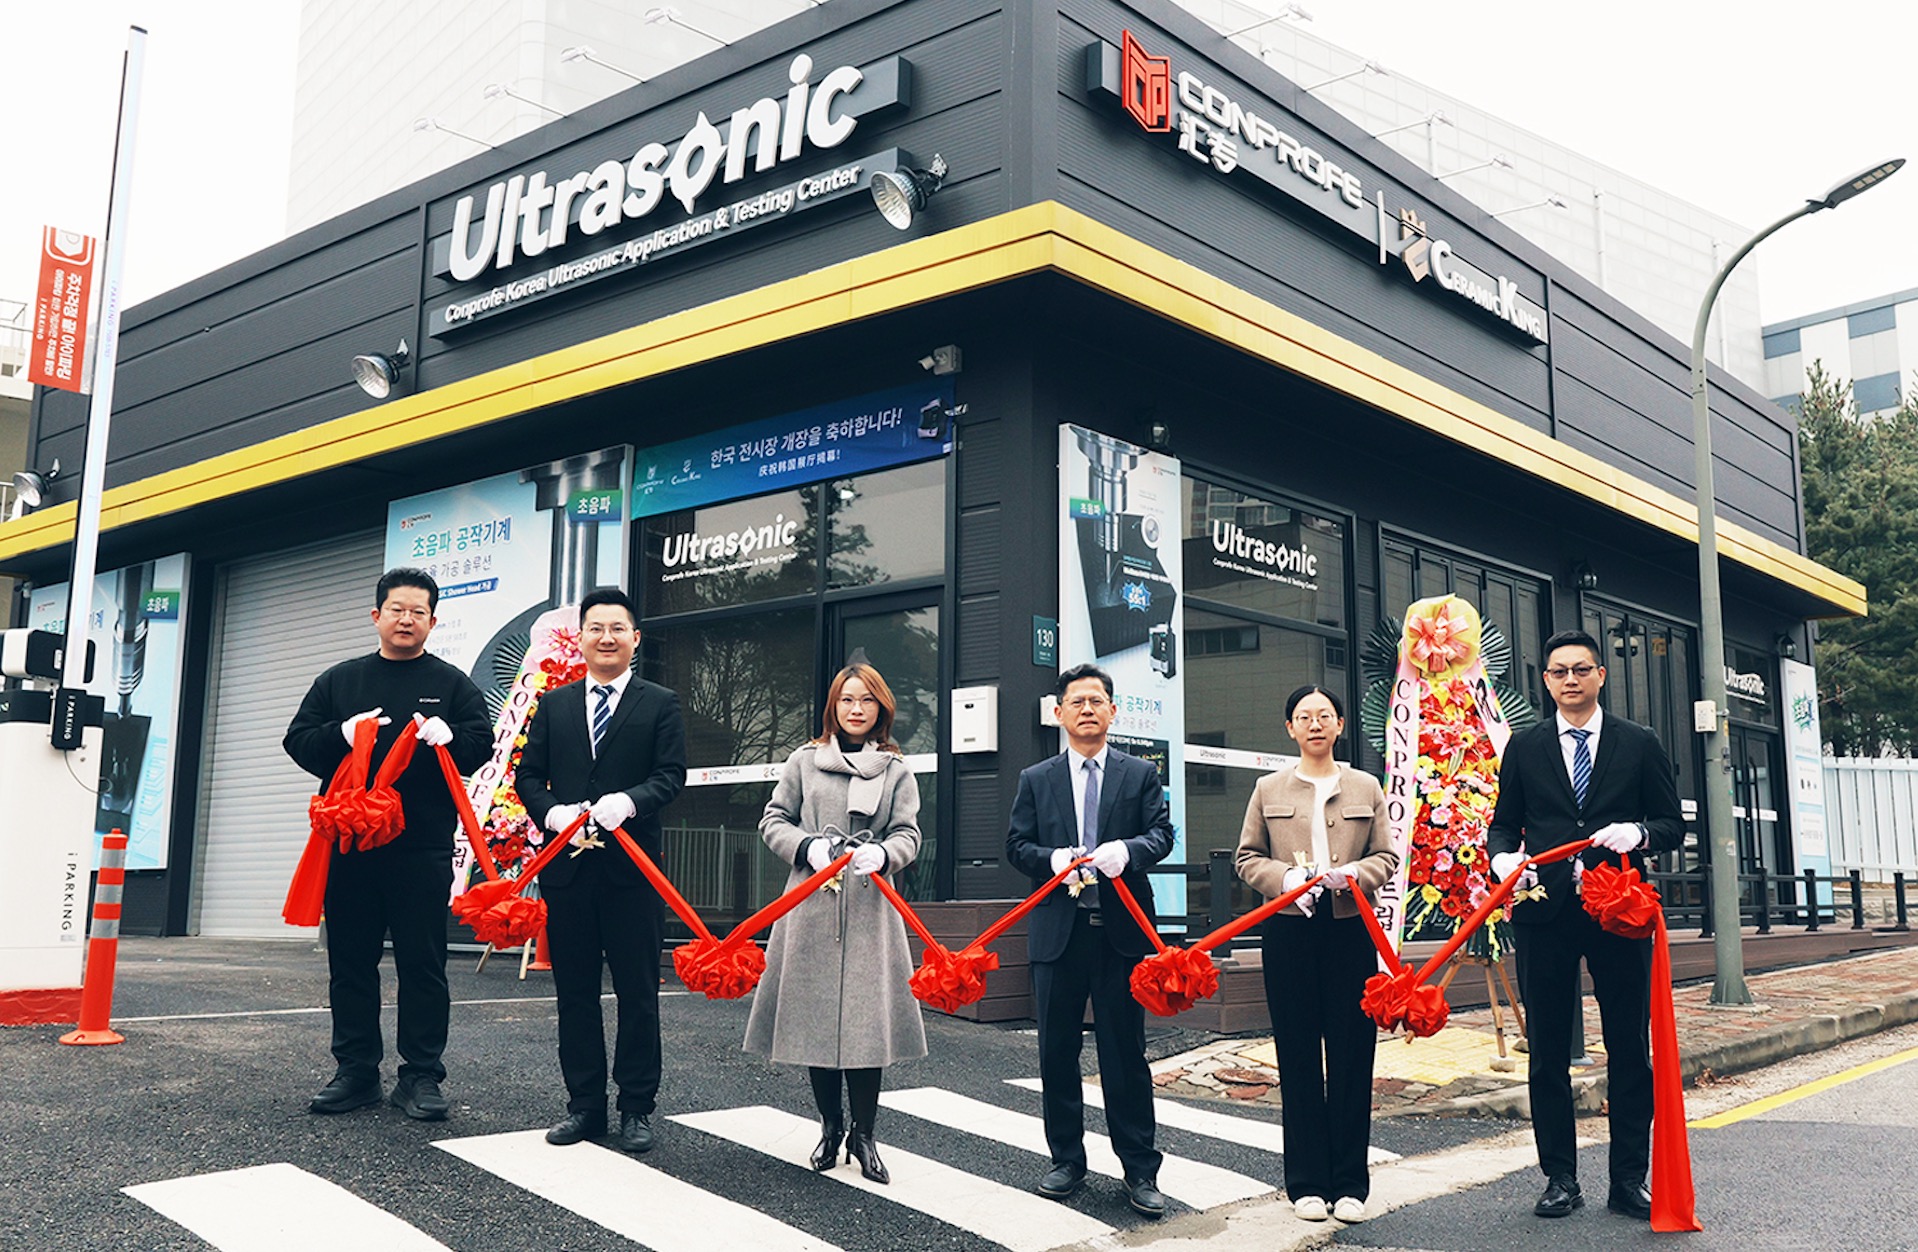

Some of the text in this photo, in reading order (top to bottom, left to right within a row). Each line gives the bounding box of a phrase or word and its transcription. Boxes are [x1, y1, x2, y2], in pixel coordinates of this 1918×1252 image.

[1178, 71, 1363, 209] CONPROFE
[1178, 111, 1238, 174] 汇专
[448, 54, 864, 282] Ultrasonic
[445, 167, 861, 324] Conprofe Korea Ultrasonic Application & Testing Center
[62, 272, 82, 318] 주차걱정
[36, 303, 47, 340] PARKING
[55, 334, 75, 380] 아이파킹
[710, 407, 903, 470] 한국 전시장 개장을 축하합니다!
[577, 495, 611, 515] 초음파
[412, 517, 511, 558] 초음파 공작기계
[663, 513, 798, 567] Ultrasonic
[1213, 519, 1318, 577] Ultrasonic
[441, 560, 460, 578] 가공
[463, 555, 492, 576] 솔루션
[147, 597, 169, 613] 초음파
[1037, 628, 1054, 648] 130
[63, 701, 75, 740] PARKING
[1126, 695, 1162, 716] 공작기계
[1388, 679, 1410, 840] CONPRO
[61, 862, 77, 931] PARKING
